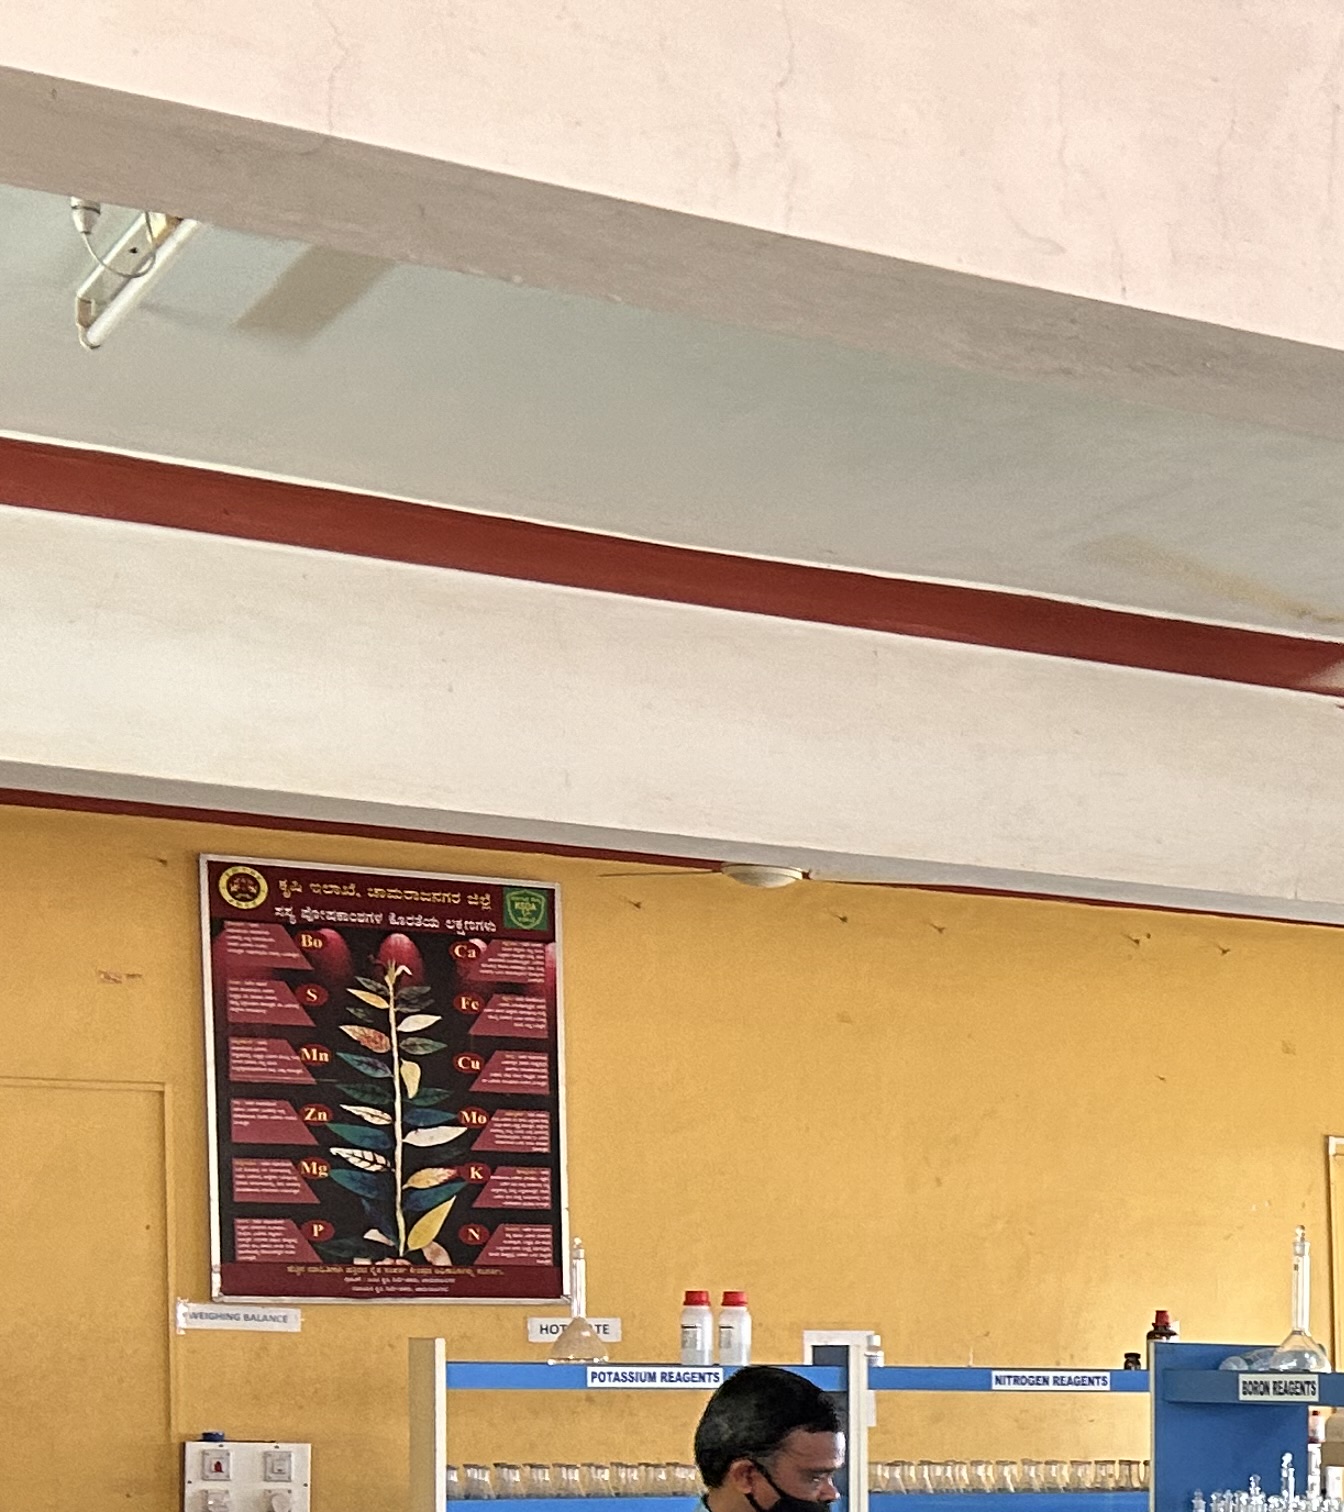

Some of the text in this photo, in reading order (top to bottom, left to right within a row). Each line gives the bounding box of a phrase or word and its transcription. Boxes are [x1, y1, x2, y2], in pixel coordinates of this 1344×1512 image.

[301, 934, 323, 948] Bo
[454, 944, 477, 958] Ca
[306, 988, 318, 1002] S
[460, 997, 480, 1010] Fe
[301, 1049, 329, 1062] Mn
[457, 1058, 480, 1069] Cu
[304, 1108, 328, 1121] Zn
[461, 1111, 487, 1124] Mo
[301, 1161, 329, 1177] Mg
[470, 1167, 483, 1180] K
[312, 1225, 324, 1237] P
[468, 1229, 480, 1241] N
[189, 1311, 288, 1323] WEIGHING BALANCE
[539, 1324, 566, 1335] HOT
[591, 1371, 720, 1384] POTASSIUM REAGENTS
[995, 1375, 1108, 1387] NITROGEN REAGENTS
[1242, 1380, 1317, 1396] BORON REAGENTS
